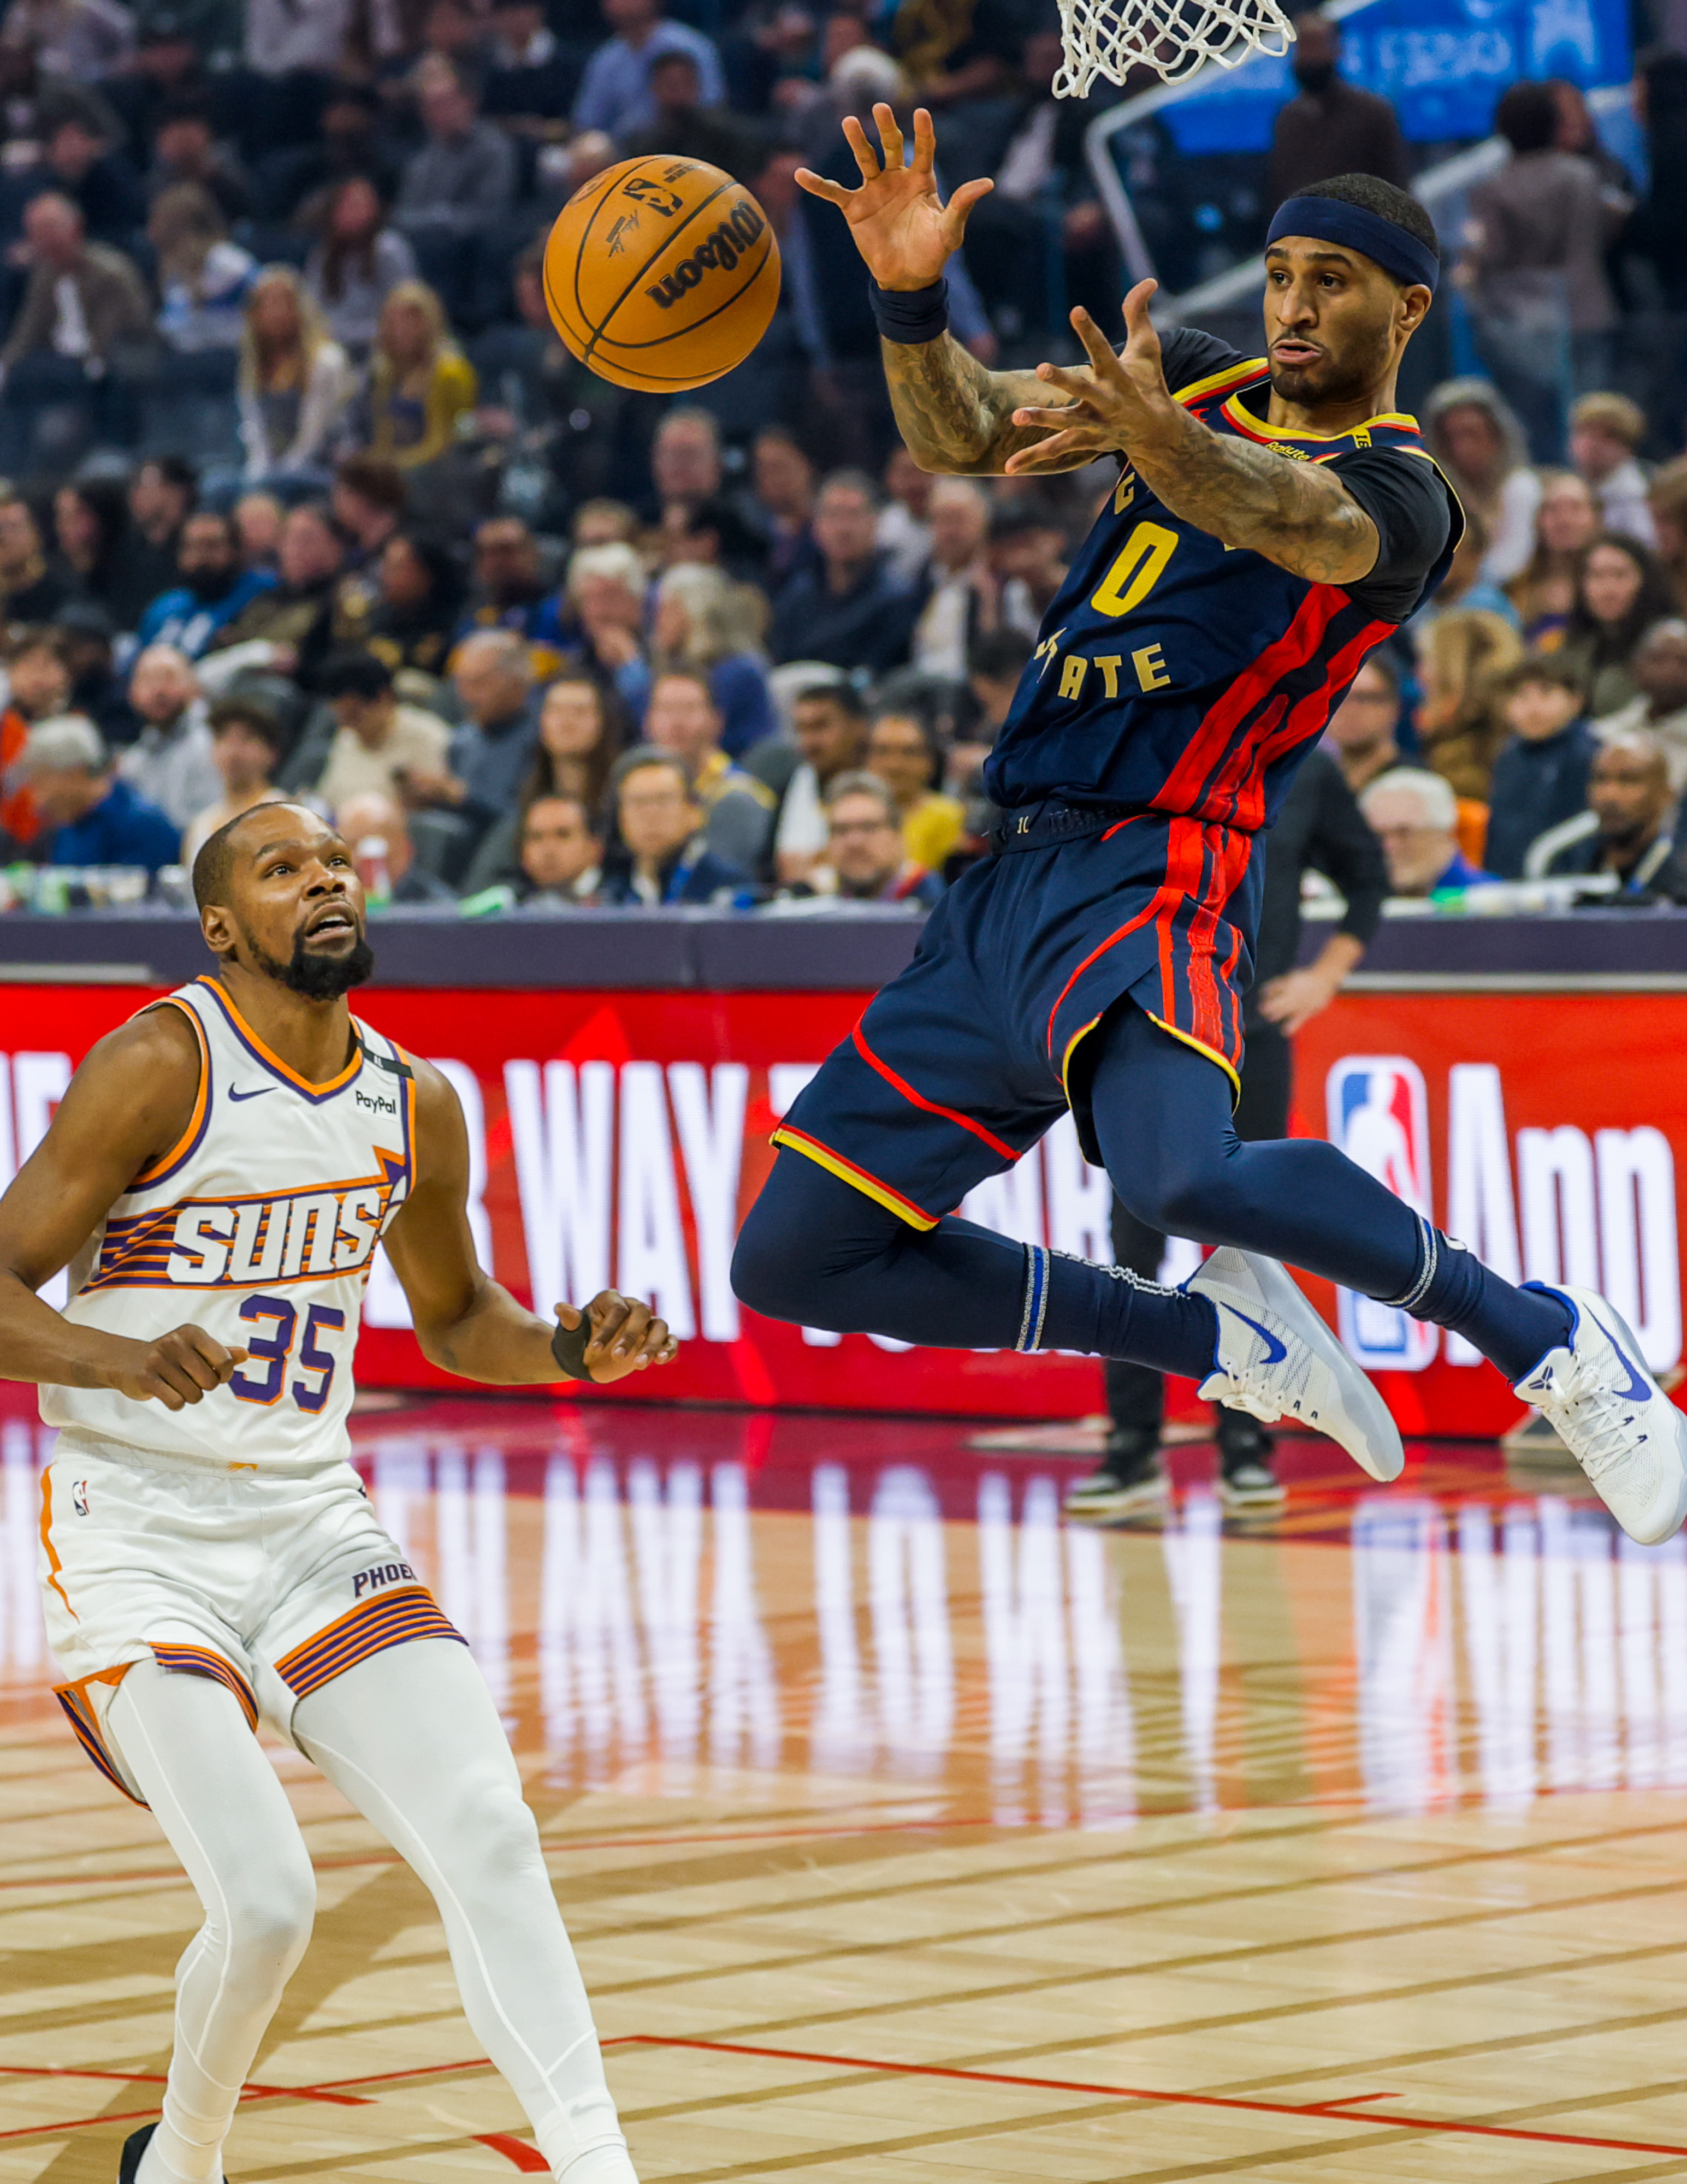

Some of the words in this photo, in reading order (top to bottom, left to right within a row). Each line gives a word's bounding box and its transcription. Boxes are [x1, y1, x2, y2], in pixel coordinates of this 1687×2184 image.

[644, 199, 765, 309] Wilson
[1265, 441, 1313, 461] Rakute
[1091, 521, 1179, 618] 0
[356, 1090, 396, 1114] PayPal
[166, 1186, 381, 1283] SUNS
[503, 1059, 749, 1342] WAY
[228, 1294, 346, 1414] 35
